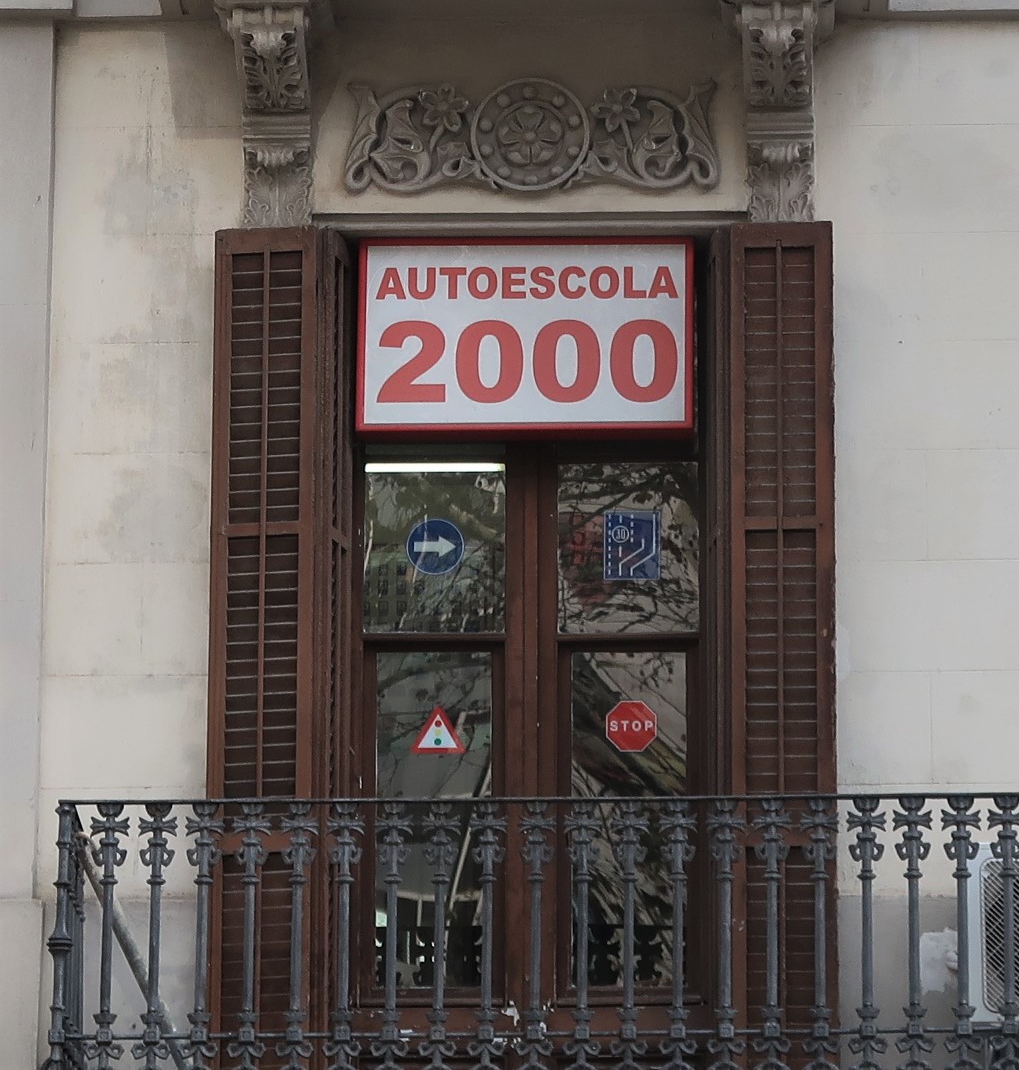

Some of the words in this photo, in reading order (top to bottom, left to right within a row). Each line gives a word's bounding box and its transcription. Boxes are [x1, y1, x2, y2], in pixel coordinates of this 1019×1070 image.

[375, 265, 679, 300] AUTOESCOLA
[376, 319, 678, 404] 2000
[615, 528, 626, 540] 30
[609, 720, 654, 732] STOP
